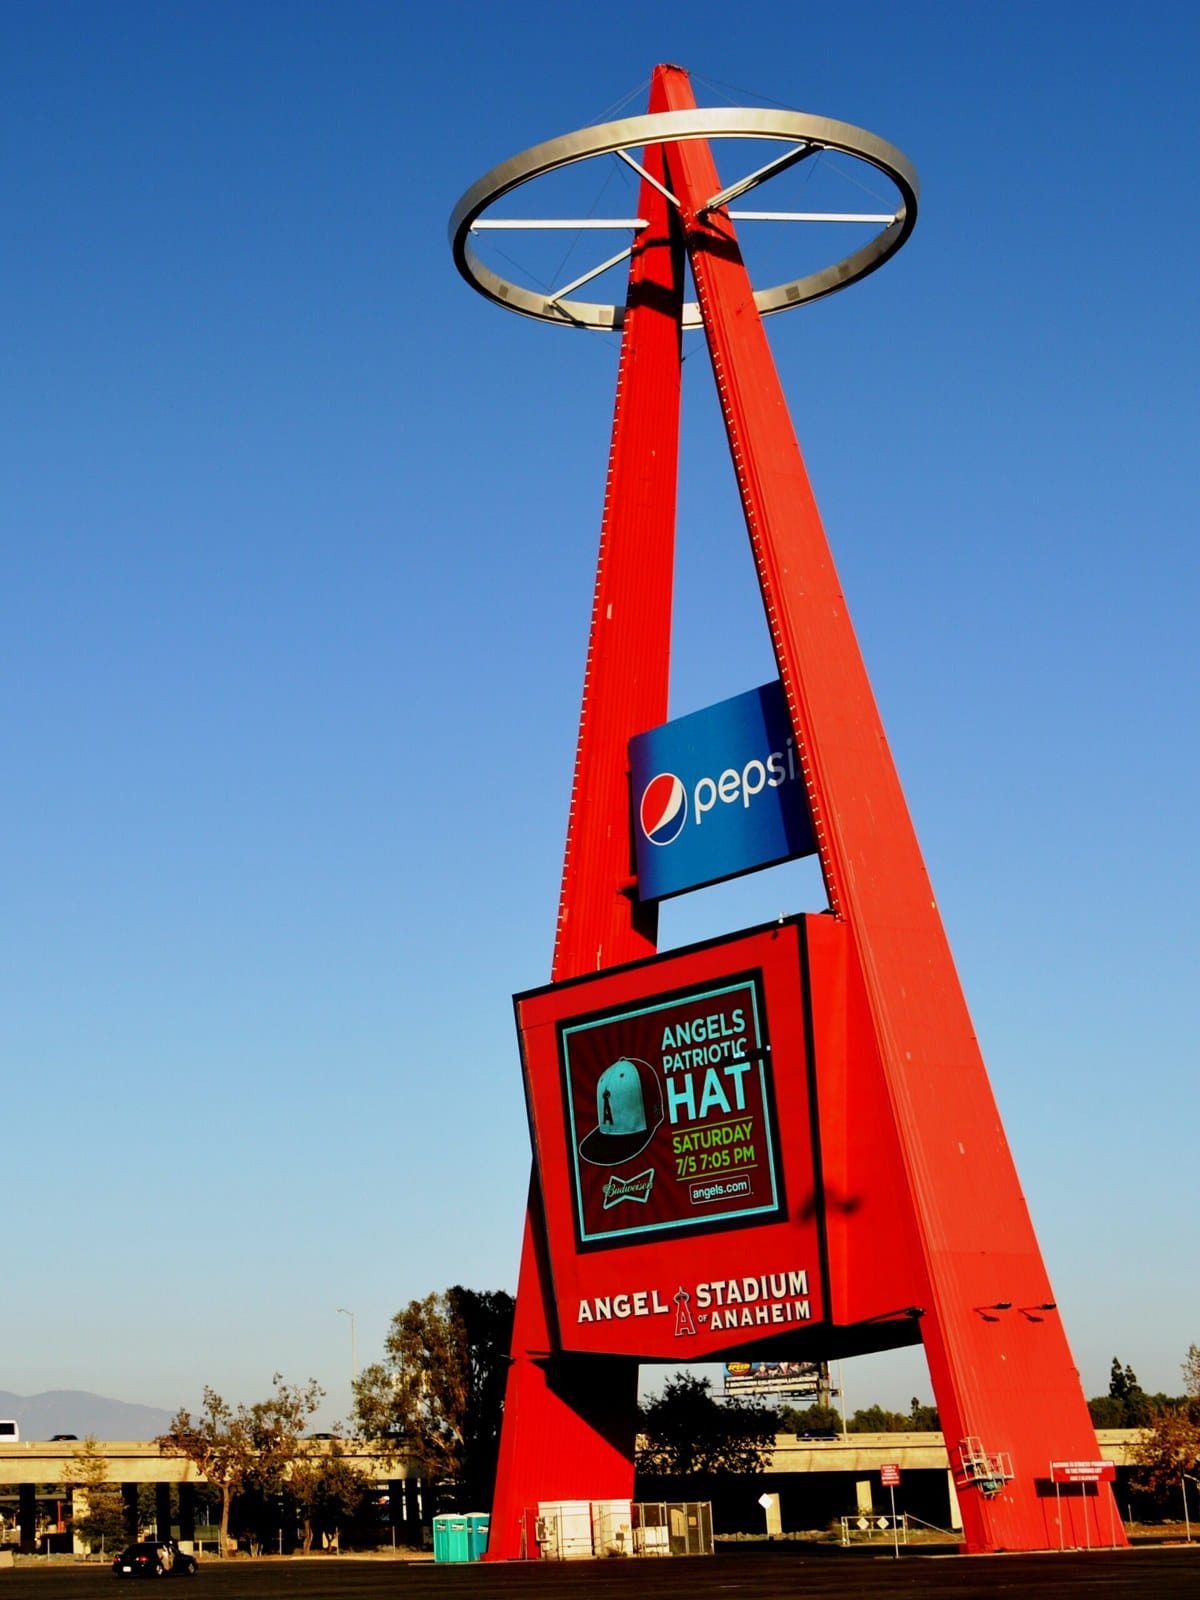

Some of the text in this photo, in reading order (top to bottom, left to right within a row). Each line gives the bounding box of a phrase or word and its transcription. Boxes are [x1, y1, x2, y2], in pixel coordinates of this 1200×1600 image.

[693, 737, 796, 826] pepsi
[661, 1008, 747, 1052] ANGELS
[662, 1037, 748, 1075] PATRIOTIC
[666, 1061, 752, 1125] HAT
[672, 1121, 753, 1154] SATURDAY
[675, 1144, 756, 1177] 7/5 7:05 PM
[692, 1181, 748, 1200] angels.com
[577, 1289, 670, 1324] ANGEL
[695, 1269, 809, 1309] STADIUM
[697, 1300, 811, 1331] OF ANAHEIM
